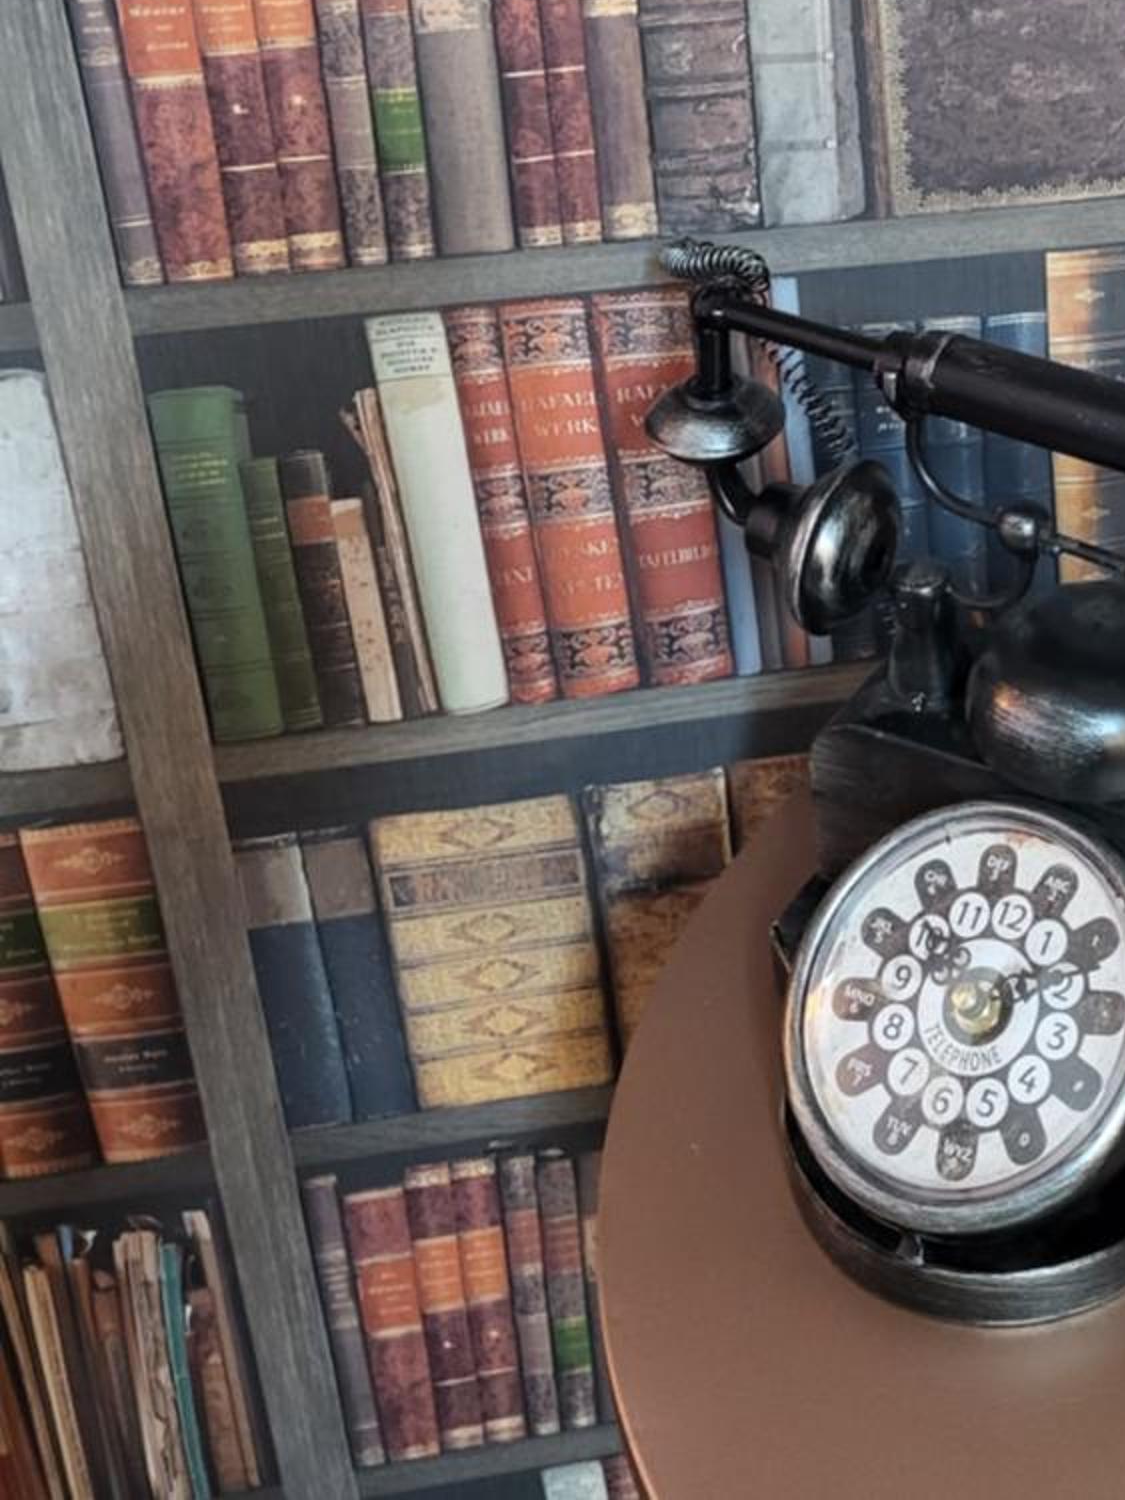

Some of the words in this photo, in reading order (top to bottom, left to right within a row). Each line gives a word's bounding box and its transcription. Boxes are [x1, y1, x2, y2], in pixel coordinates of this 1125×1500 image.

[957, 901, 983, 931] 11
[998, 901, 1027, 932] 12
[1040, 931, 1053, 956] 1
[892, 965, 912, 990] 9
[883, 1012, 905, 1040] 8
[1046, 1022, 1068, 1050] 3
[924, 1023, 1002, 1071] TELEPHONE
[900, 1056, 919, 1085] 7
[1018, 1065, 1037, 1095] 4
[932, 1088, 953, 1115] 6
[976, 1088, 999, 1117] 5
